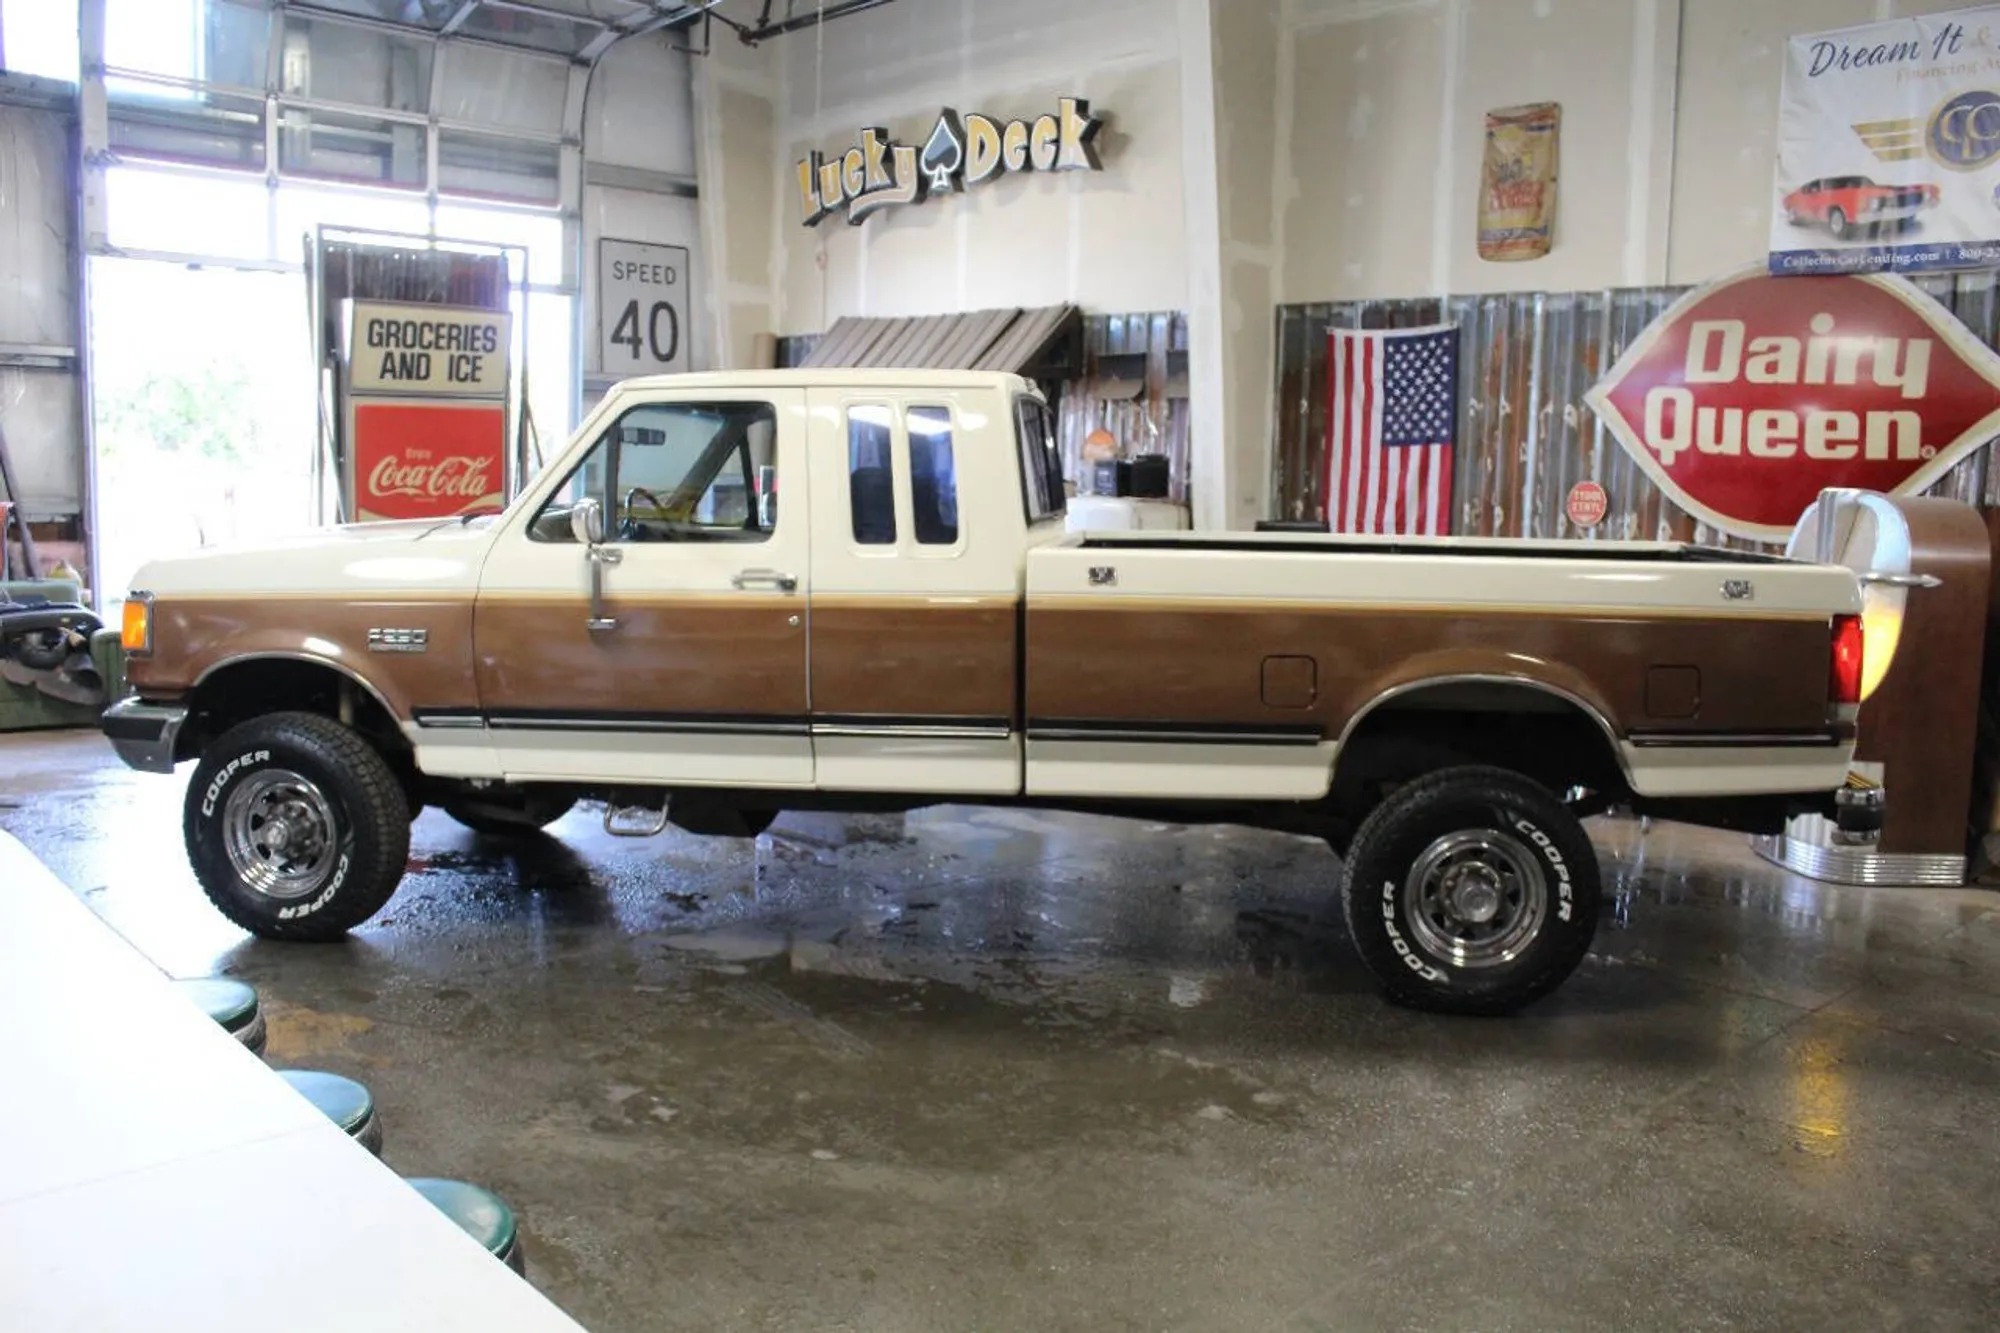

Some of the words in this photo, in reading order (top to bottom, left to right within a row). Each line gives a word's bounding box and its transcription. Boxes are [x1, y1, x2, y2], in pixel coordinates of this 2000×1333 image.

[1808, 40, 1920, 78] Dream
[1932, 22, 1964, 60] It
[797, 127, 924, 226] Lucky
[964, 97, 1103, 184] Deck
[612, 260, 677, 286] SPEED
[367, 317, 498, 354] GROCERIES
[610, 299, 680, 363] 40
[1684, 312, 1933, 399] Dairy
[379, 352, 431, 382] AND
[447, 355, 482, 383] ICE
[1644, 386, 1923, 467] Queen
[368, 454, 495, 497] Coca-Cola
[201, 749, 271, 818] COOPER
[277, 853, 349, 920] COOPER
[1515, 819, 1574, 923] COOPER
[1382, 880, 1439, 981] COOPER
